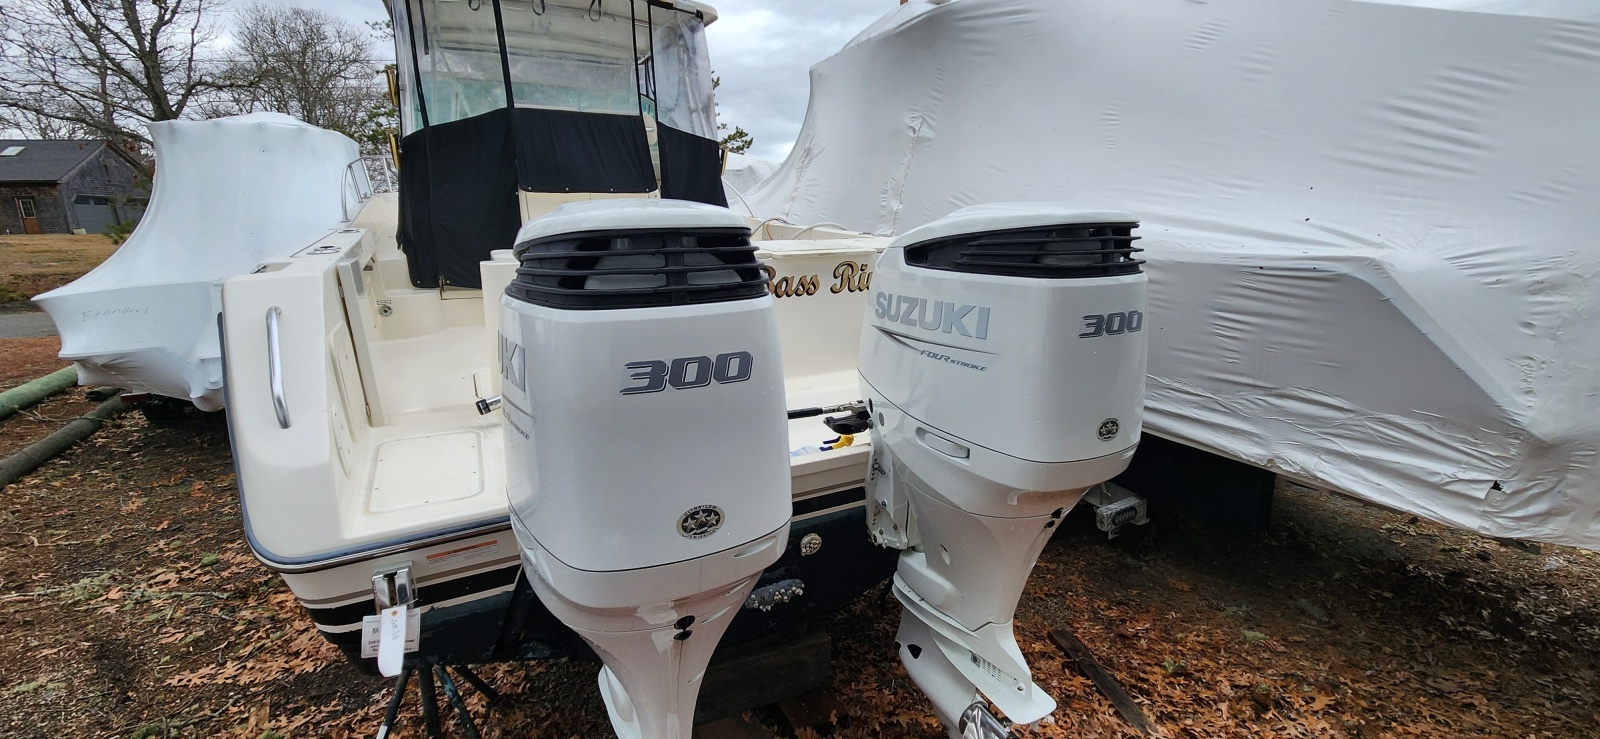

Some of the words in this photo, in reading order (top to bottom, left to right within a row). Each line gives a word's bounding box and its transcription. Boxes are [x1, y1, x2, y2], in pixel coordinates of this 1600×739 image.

[874, 291, 990, 340] SUZUKI
[1078, 310, 1144, 339] 300
[619, 351, 753, 395] 300
